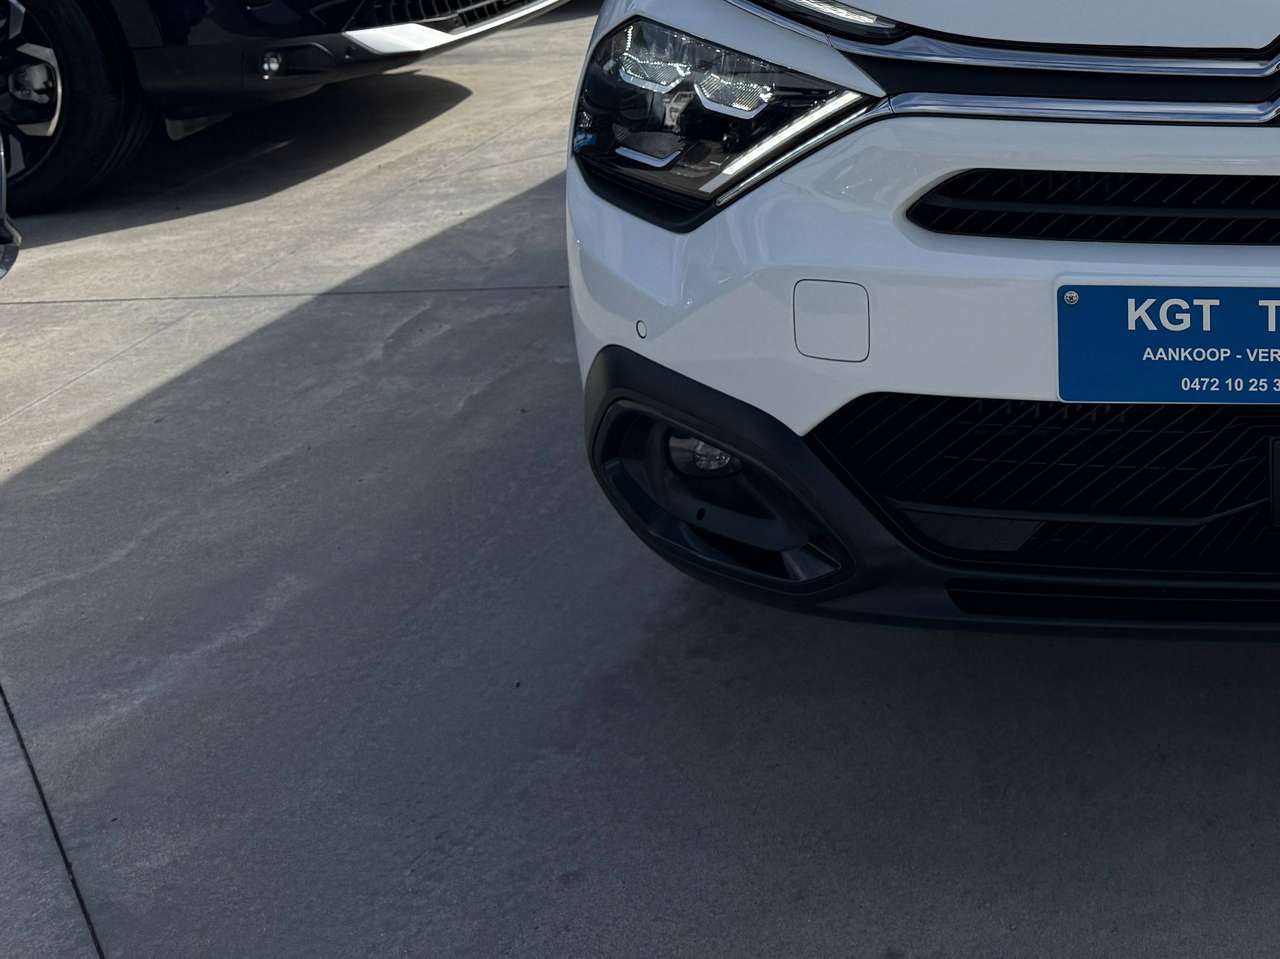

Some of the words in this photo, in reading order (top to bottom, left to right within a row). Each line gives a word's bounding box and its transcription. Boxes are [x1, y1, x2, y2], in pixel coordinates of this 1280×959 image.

[1127, 297, 1220, 332] KGT
[1142, 347, 1231, 362] AANKOOP
[1181, 377, 1220, 392] 0472
[1225, 378, 1244, 392] 10
[1248, 378, 1268, 392] 25
